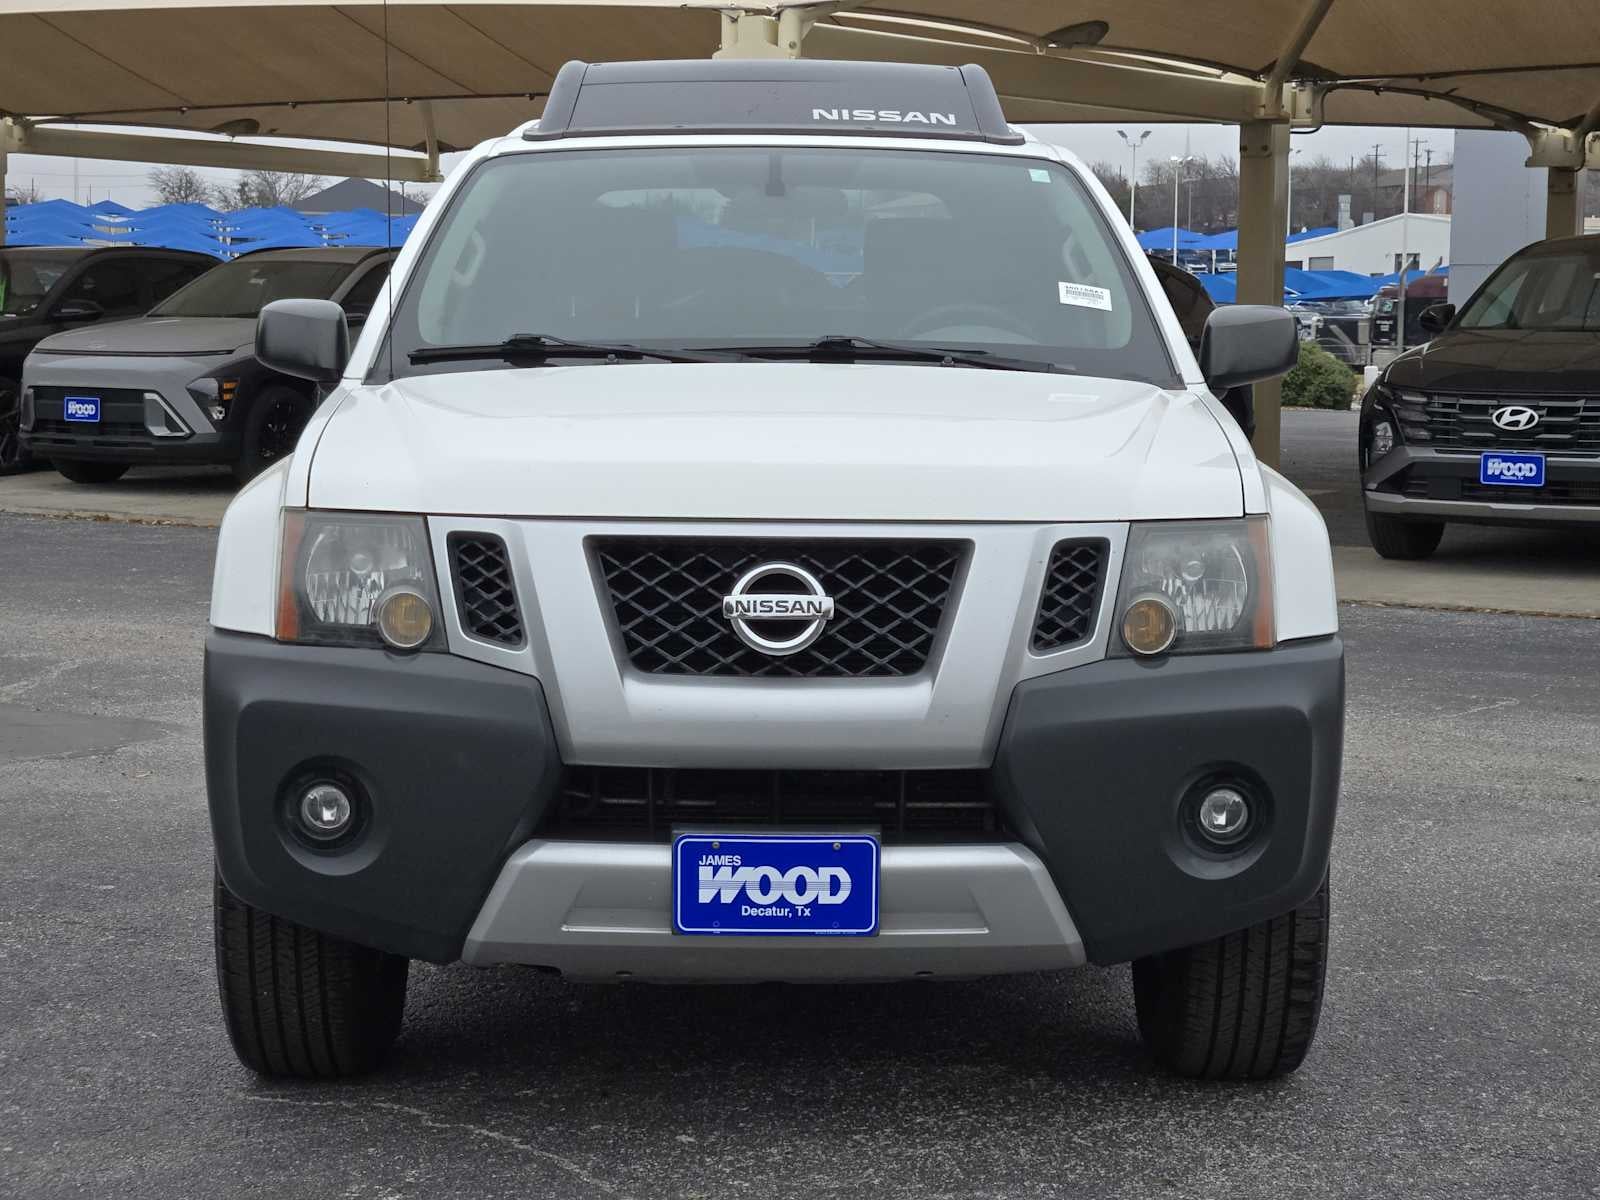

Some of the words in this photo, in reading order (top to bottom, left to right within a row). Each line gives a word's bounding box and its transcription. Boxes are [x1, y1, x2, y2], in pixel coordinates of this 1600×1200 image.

[812, 108, 956, 125] NISSAN
[68, 403, 96, 415] WOOD
[1487, 461, 1537, 477] WOOD
[735, 600, 823, 614] NISSAN
[698, 855, 742, 866] JAMES
[698, 865, 852, 906] WOOD
[741, 905, 793, 918] Decatur,
[795, 905, 811, 917] Tx
